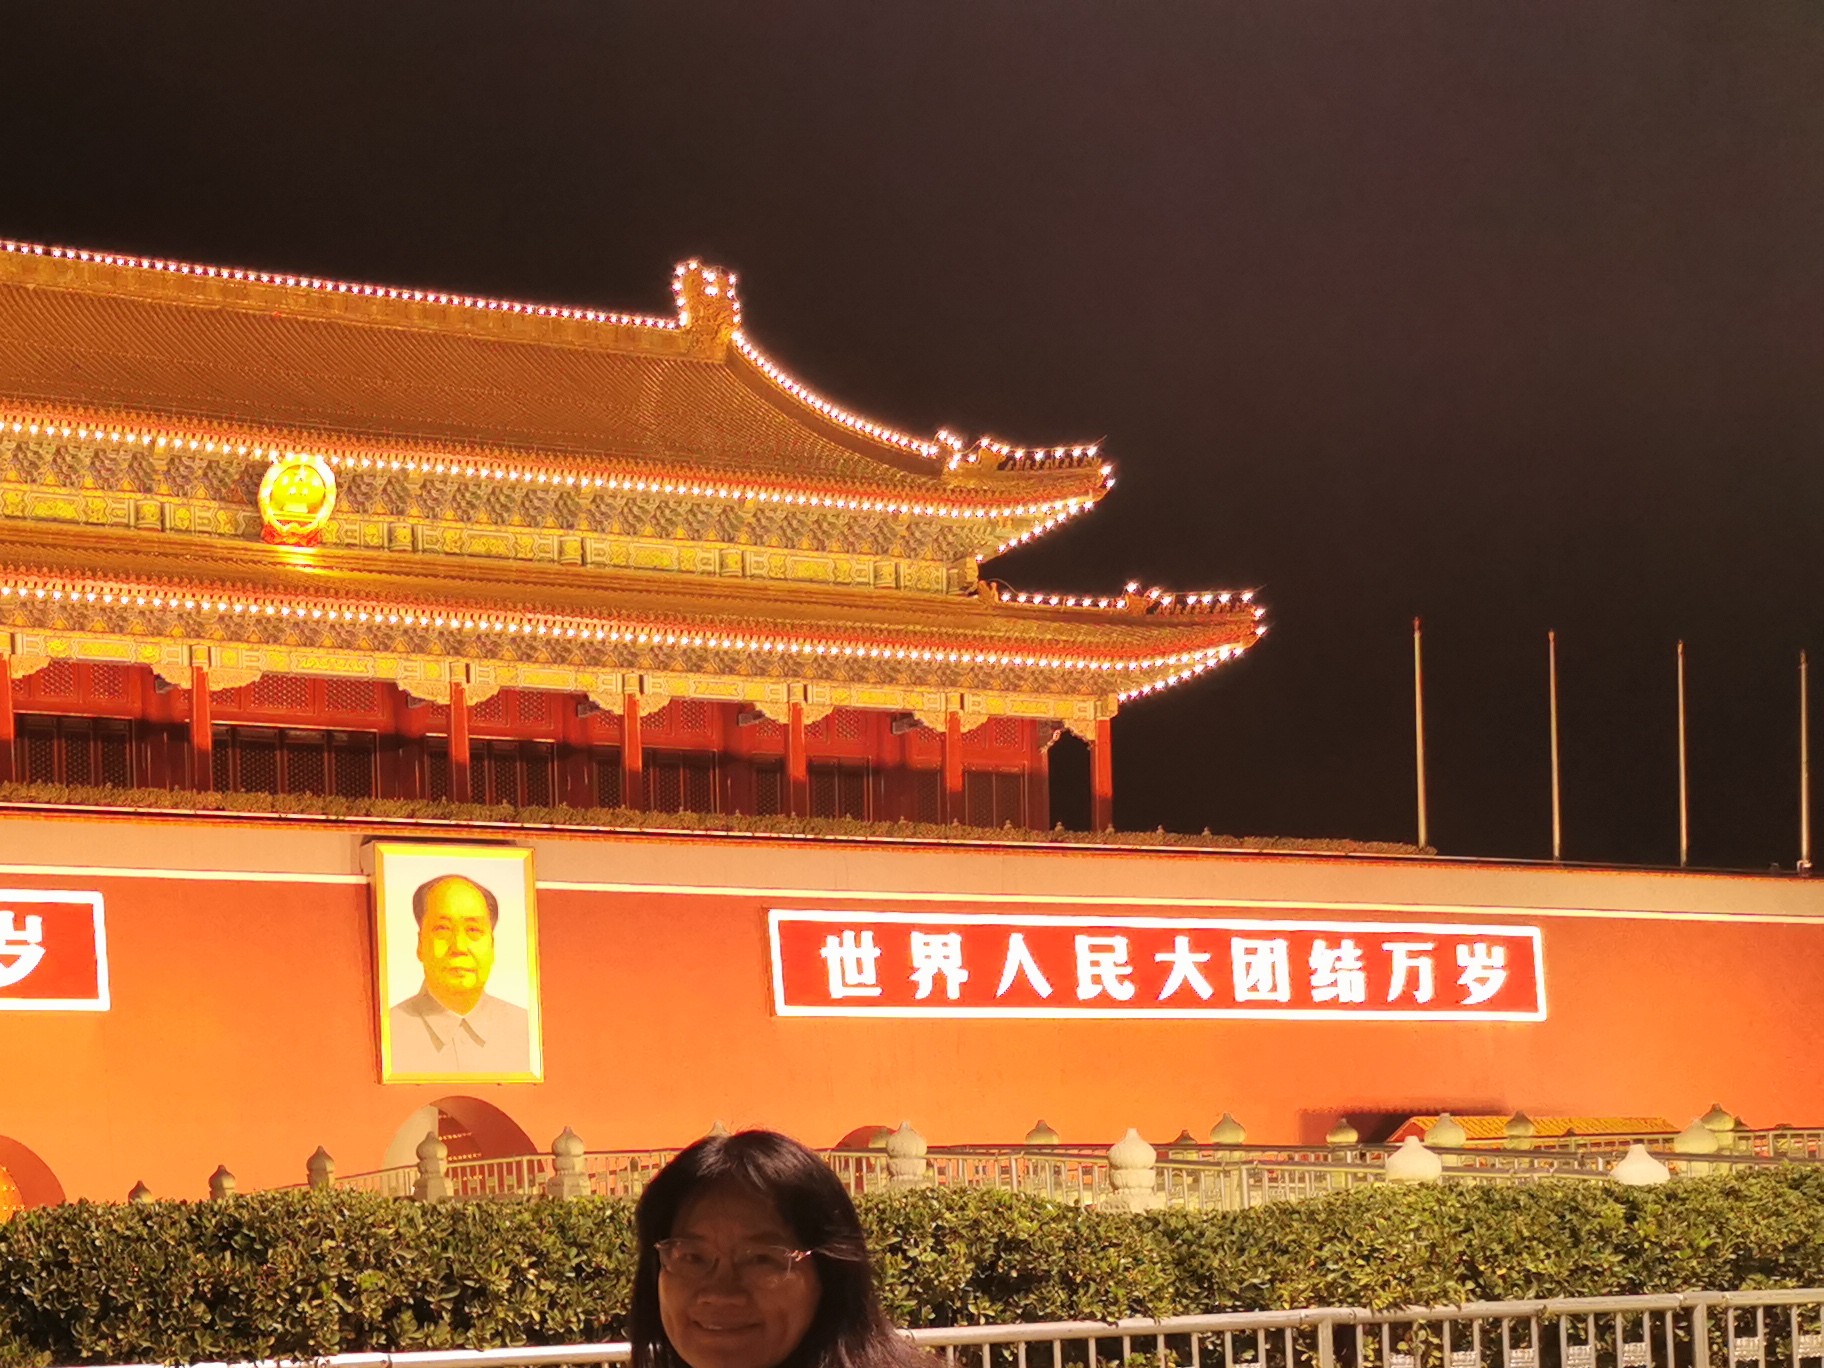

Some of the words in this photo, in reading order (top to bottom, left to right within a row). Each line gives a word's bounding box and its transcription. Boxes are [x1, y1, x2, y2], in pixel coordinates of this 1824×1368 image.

[819, 930, 1509, 1005] 世界人民大团结万岁
